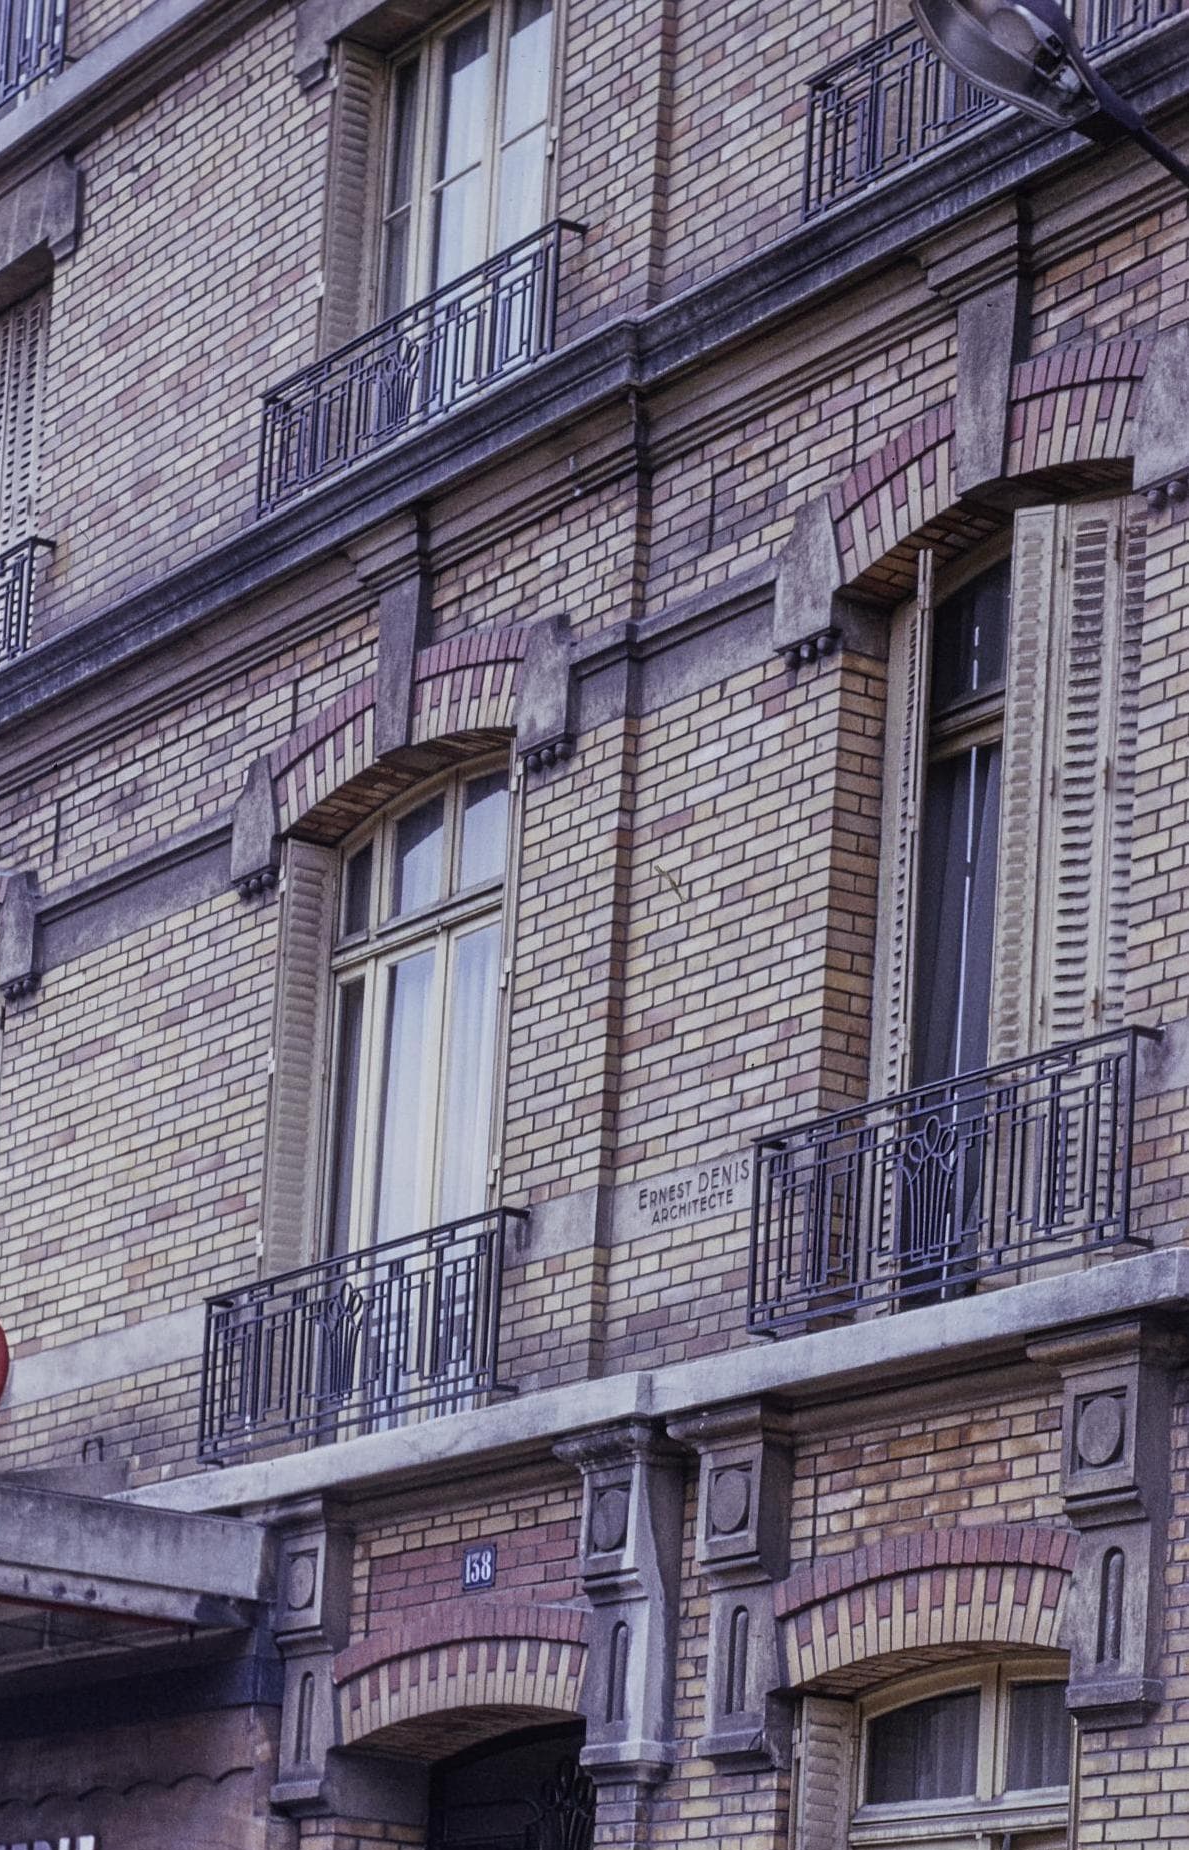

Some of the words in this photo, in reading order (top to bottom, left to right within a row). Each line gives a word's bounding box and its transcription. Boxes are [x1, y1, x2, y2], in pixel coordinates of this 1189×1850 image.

[638, 1180, 692, 1210] ERNEST
[698, 1159, 750, 1193] DENIS
[651, 1188, 734, 1225] ARCHITECTE
[465, 1550, 492, 1584] 138
